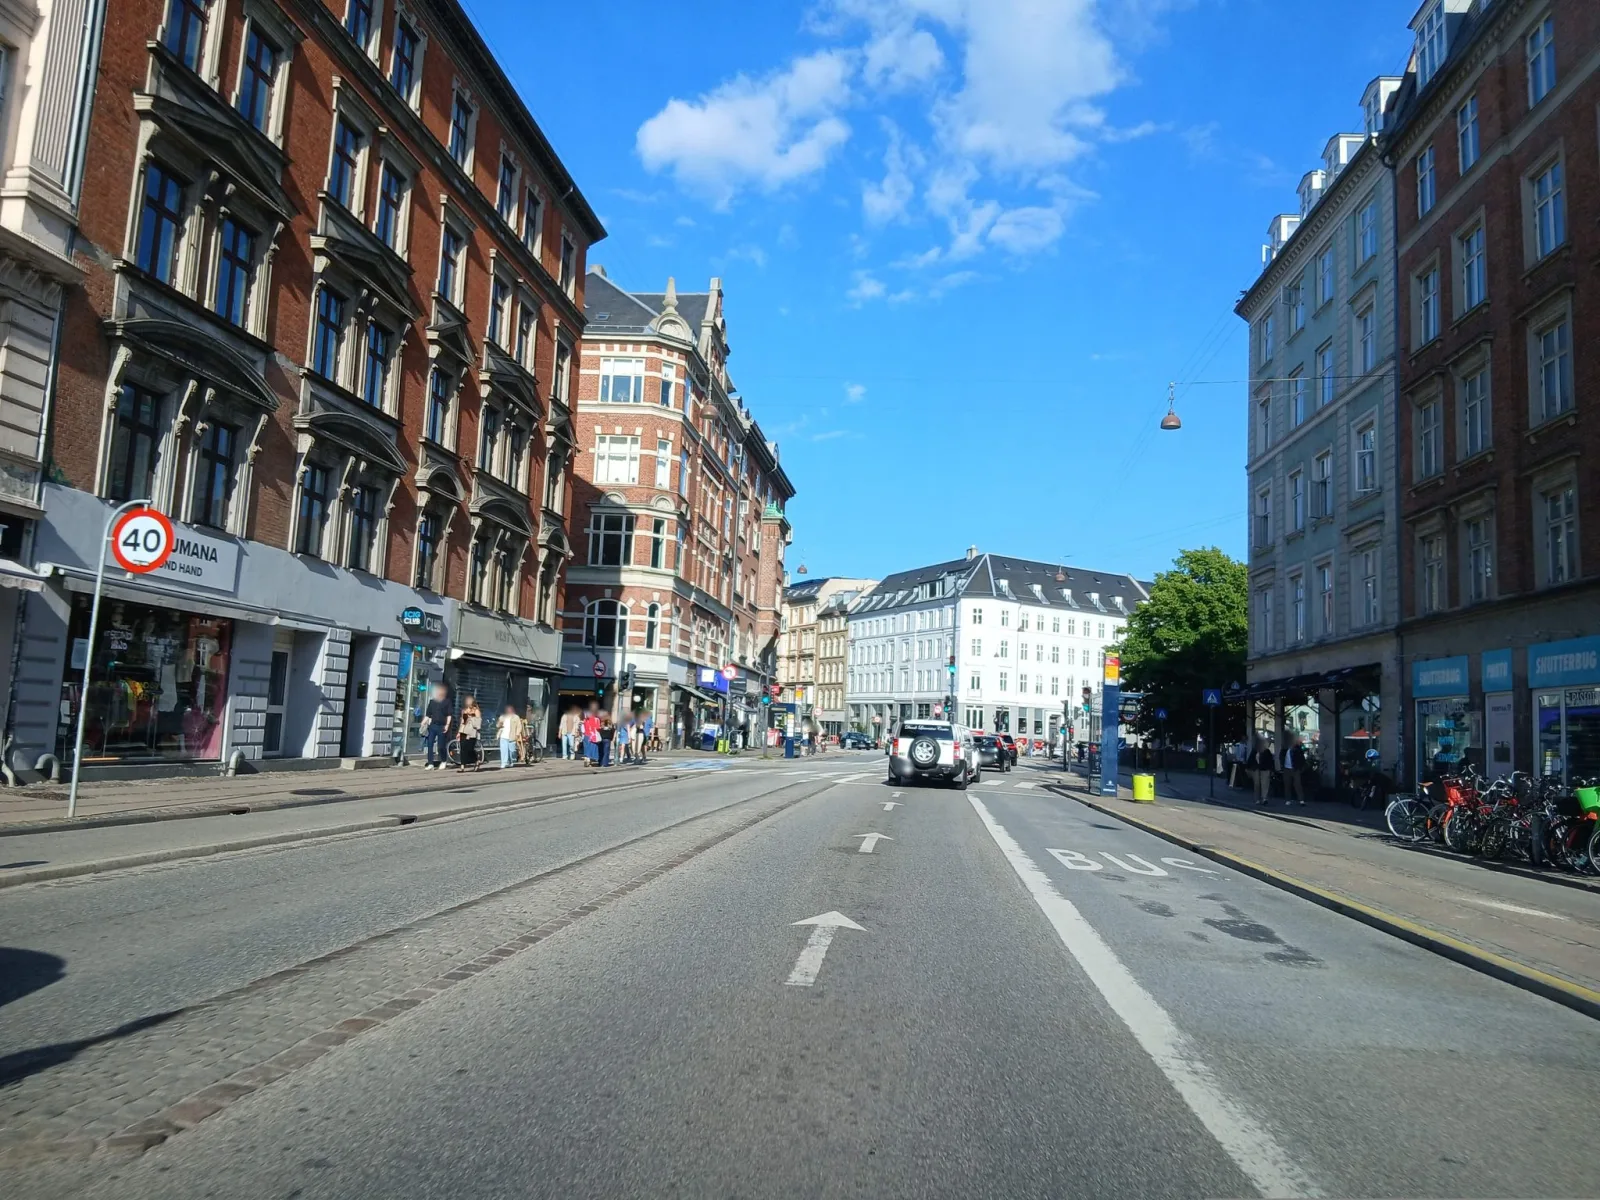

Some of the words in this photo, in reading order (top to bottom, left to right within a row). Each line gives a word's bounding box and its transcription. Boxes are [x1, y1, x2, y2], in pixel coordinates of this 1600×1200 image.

[122, 528, 161, 553] 40
[172, 538, 218, 563] UMANA
[179, 562, 203, 577] HAND
[403, 617, 421, 625] CLUB
[426, 617, 442, 632] CLUB
[1535, 650, 1597, 674] SHUTTERBUG
